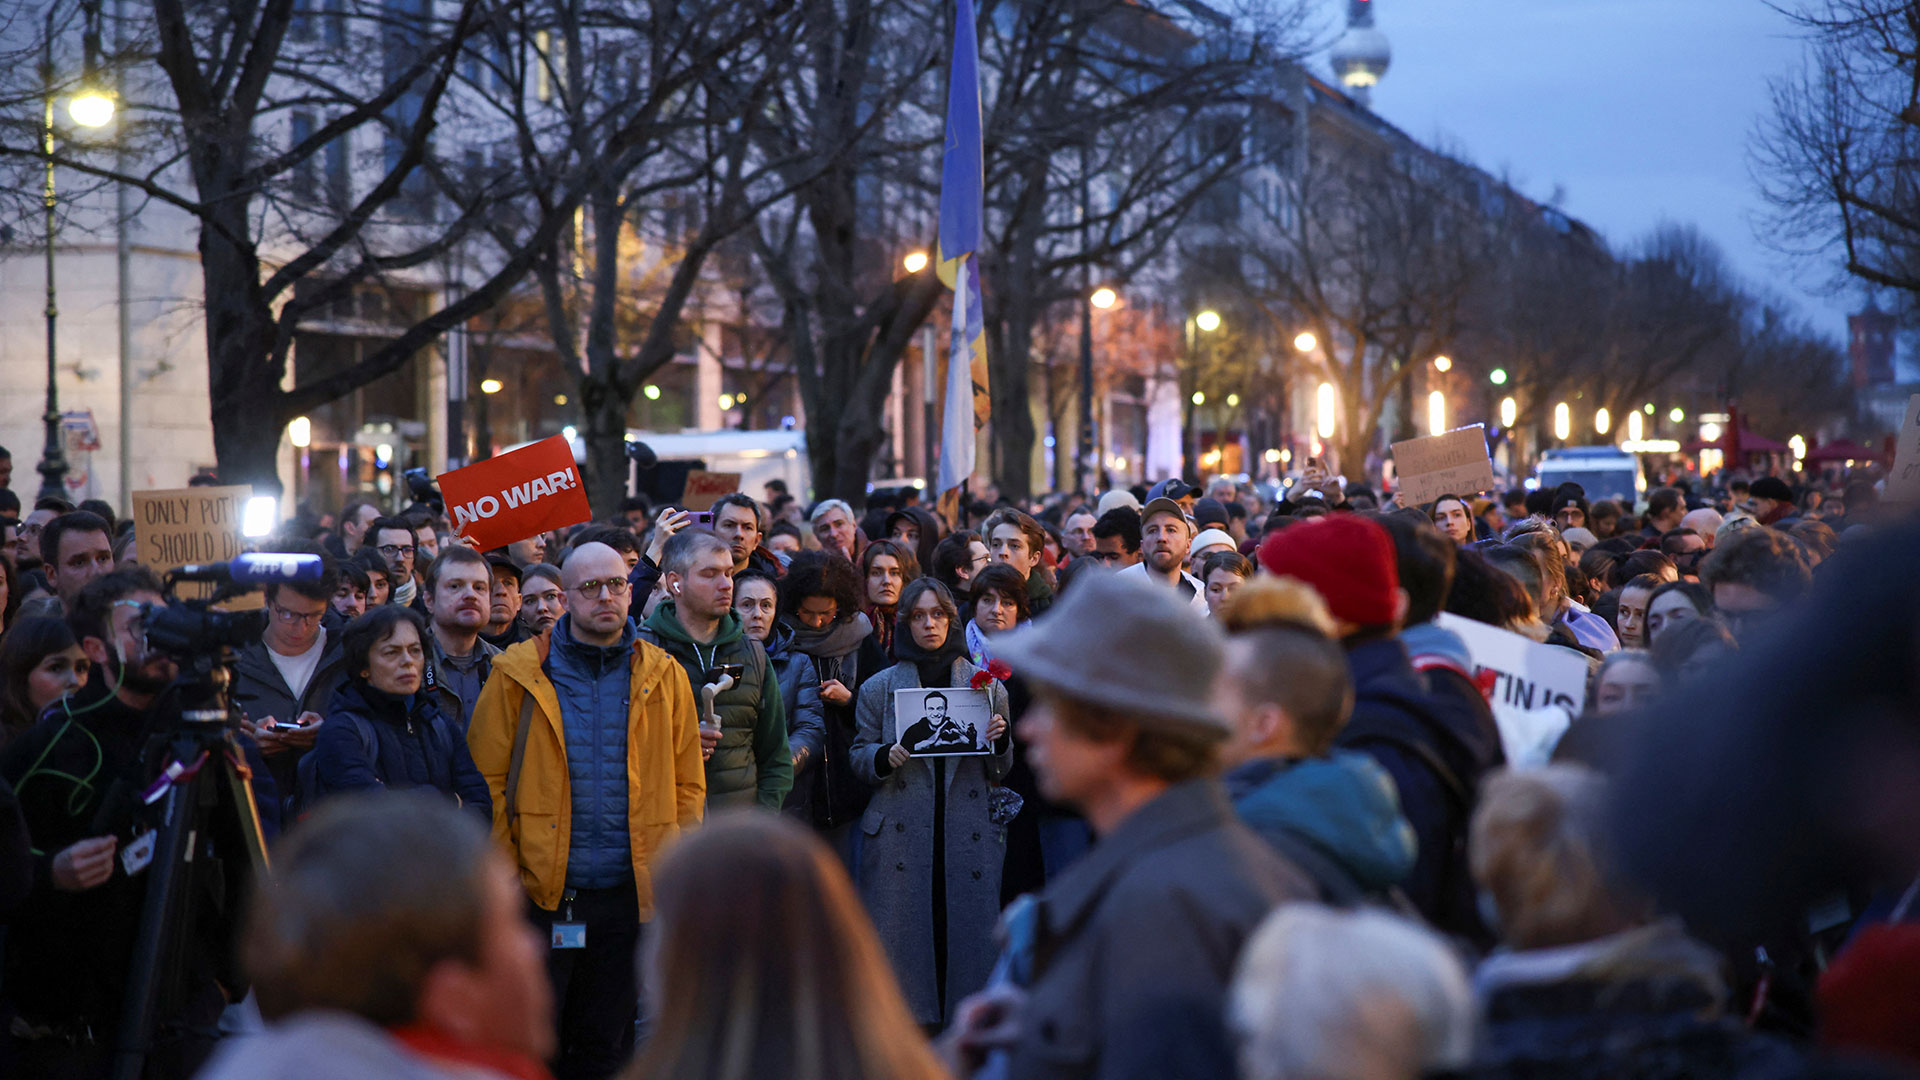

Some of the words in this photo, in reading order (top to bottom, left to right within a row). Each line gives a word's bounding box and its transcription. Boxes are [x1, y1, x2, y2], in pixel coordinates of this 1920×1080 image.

[144, 498, 190, 526] ONLY
[200, 495, 242, 525] PUTI
[453, 495, 500, 523] NO
[501, 467, 577, 510] WAR!
[150, 531, 214, 565] SHOULD
[222, 531, 243, 561] DI
[426, 661, 434, 685] SON
[1473, 664, 1535, 711] TIN
